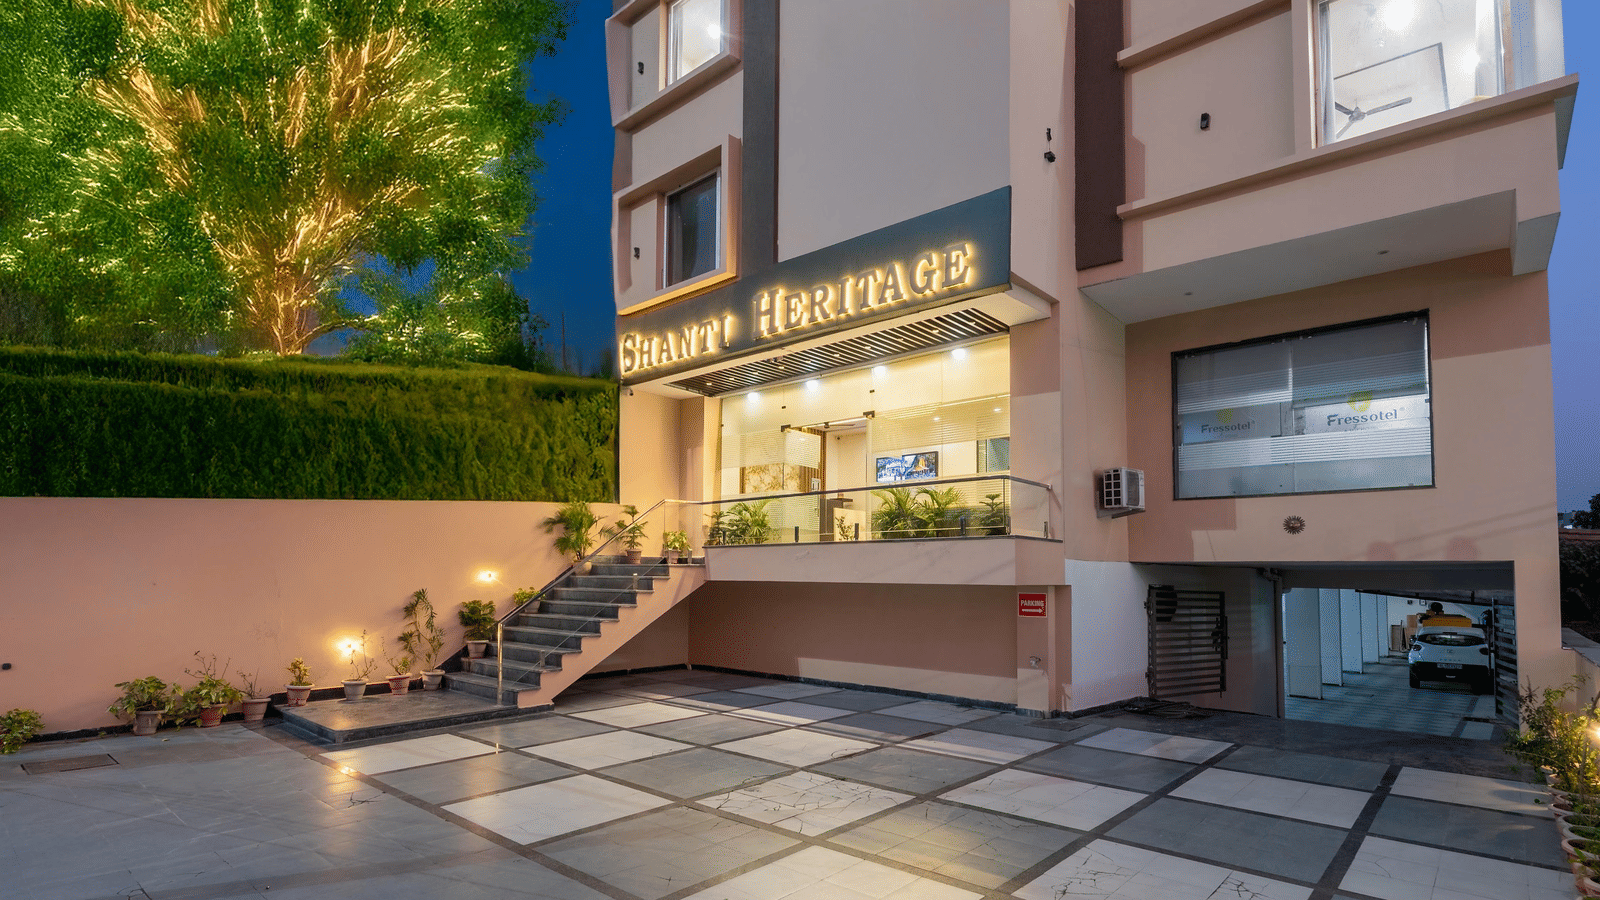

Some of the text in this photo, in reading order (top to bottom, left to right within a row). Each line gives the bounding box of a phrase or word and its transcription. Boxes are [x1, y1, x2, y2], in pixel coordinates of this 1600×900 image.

[620, 242, 972, 374] SHANTI HERITAGE
[1327, 408, 1398, 427] Fressotel
[1201, 421, 1251, 434] Fressotel
